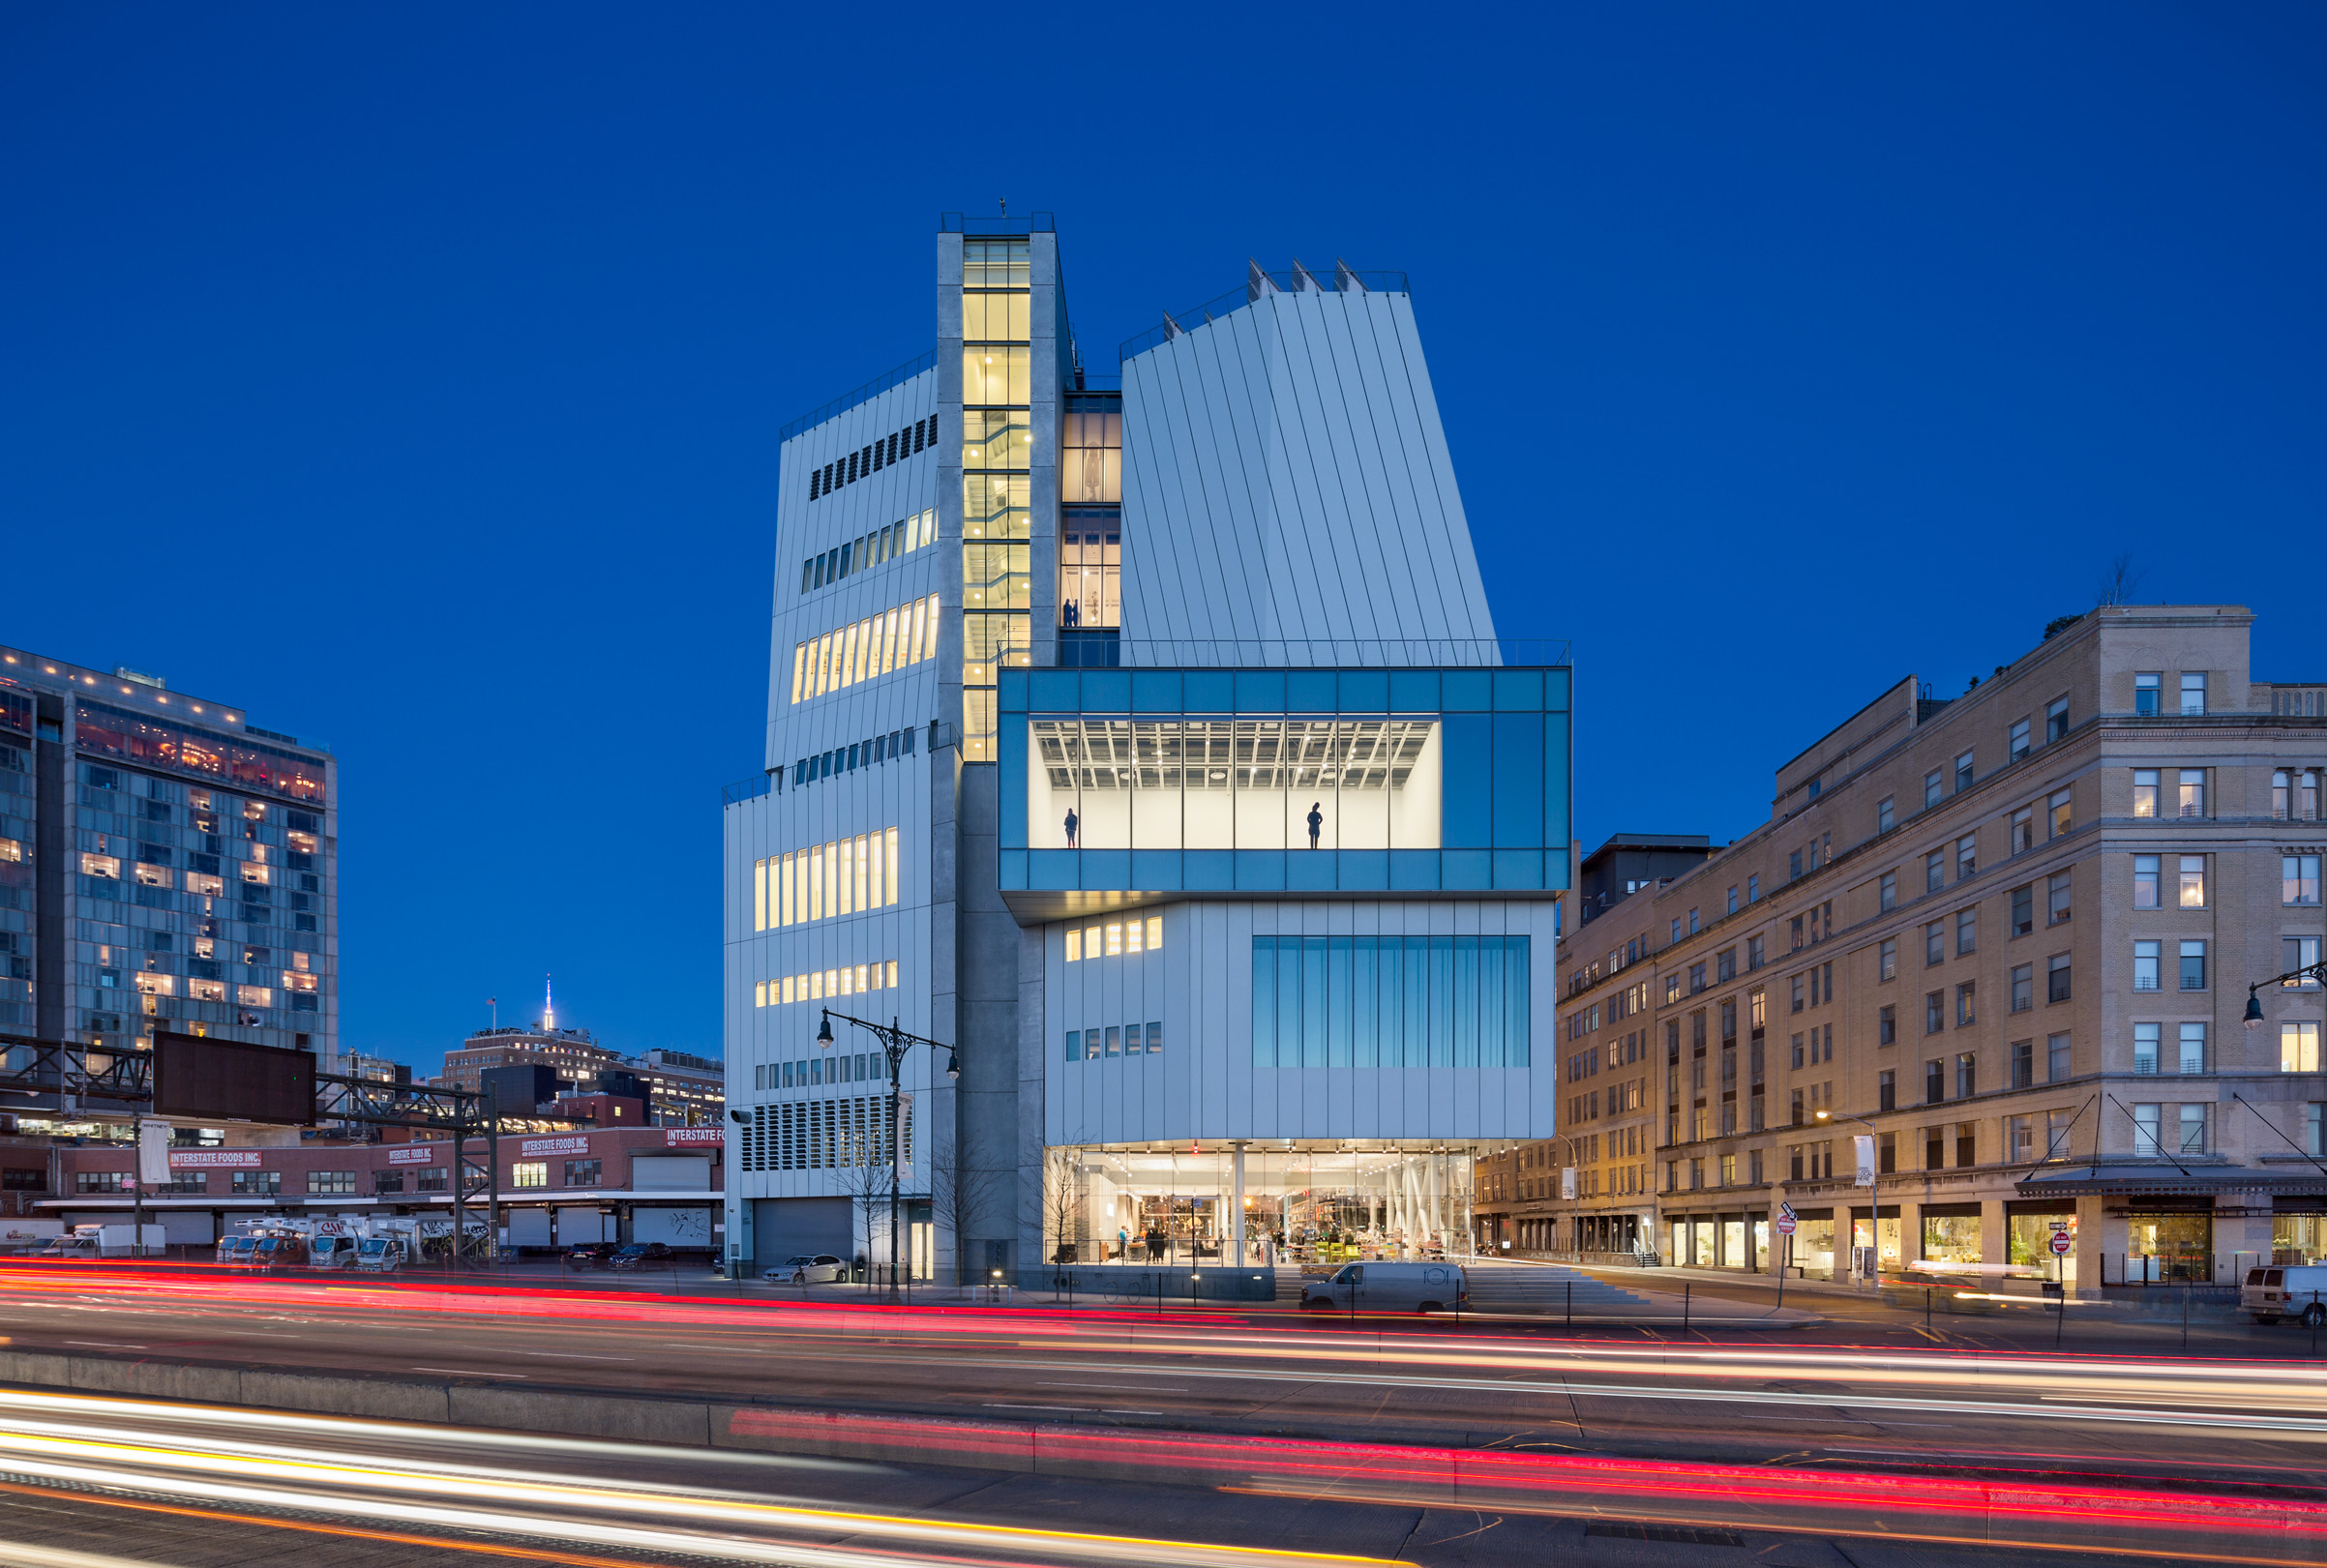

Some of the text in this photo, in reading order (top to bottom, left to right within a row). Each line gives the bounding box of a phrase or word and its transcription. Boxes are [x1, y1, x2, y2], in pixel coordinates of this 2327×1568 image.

[668, 1129, 716, 1140] INTERSTATE
[522, 1137, 588, 1151] INTERSTATE FOODS INC.
[170, 1152, 261, 1163] INTERSTATE FOODS INC.
